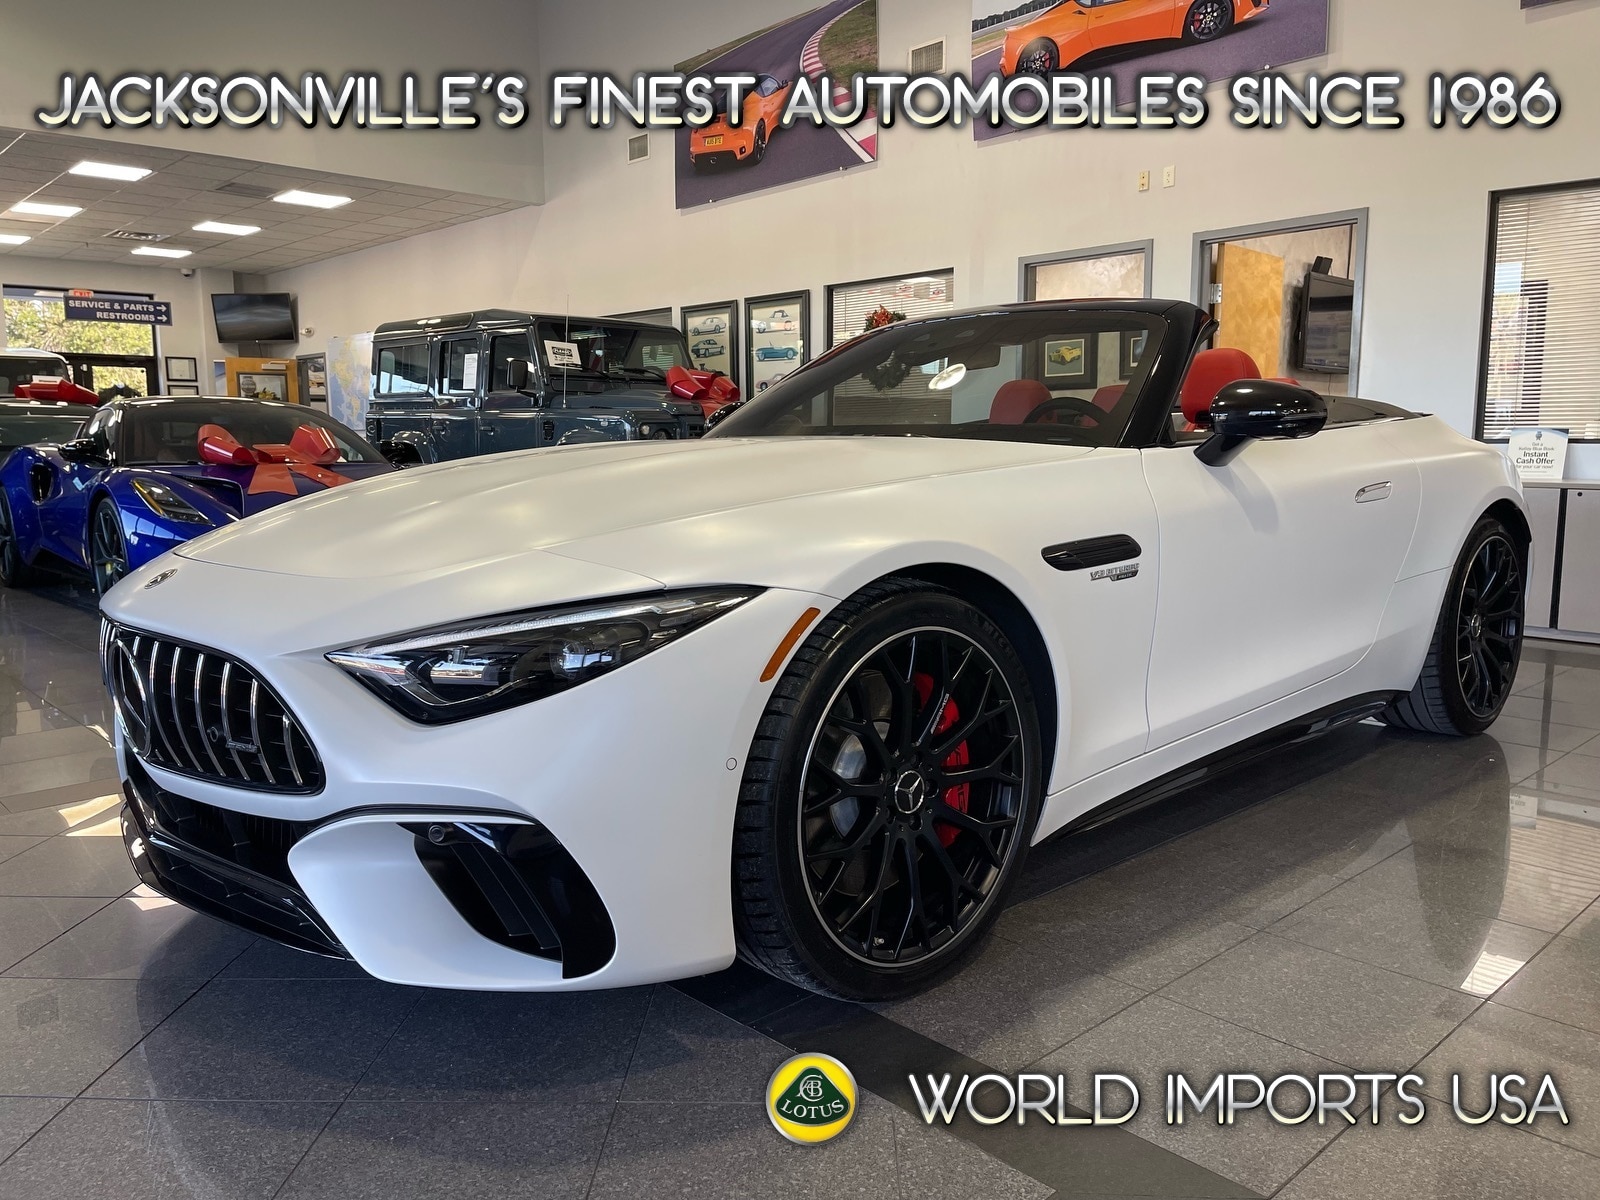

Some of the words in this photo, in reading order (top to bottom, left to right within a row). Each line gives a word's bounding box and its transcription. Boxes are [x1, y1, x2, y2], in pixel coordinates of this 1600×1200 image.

[68, 300, 111, 309] SERVICE
[113, 302, 121, 310] &
[123, 303, 155, 312] PARTS
[96, 311, 156, 322] RESTROOMS
